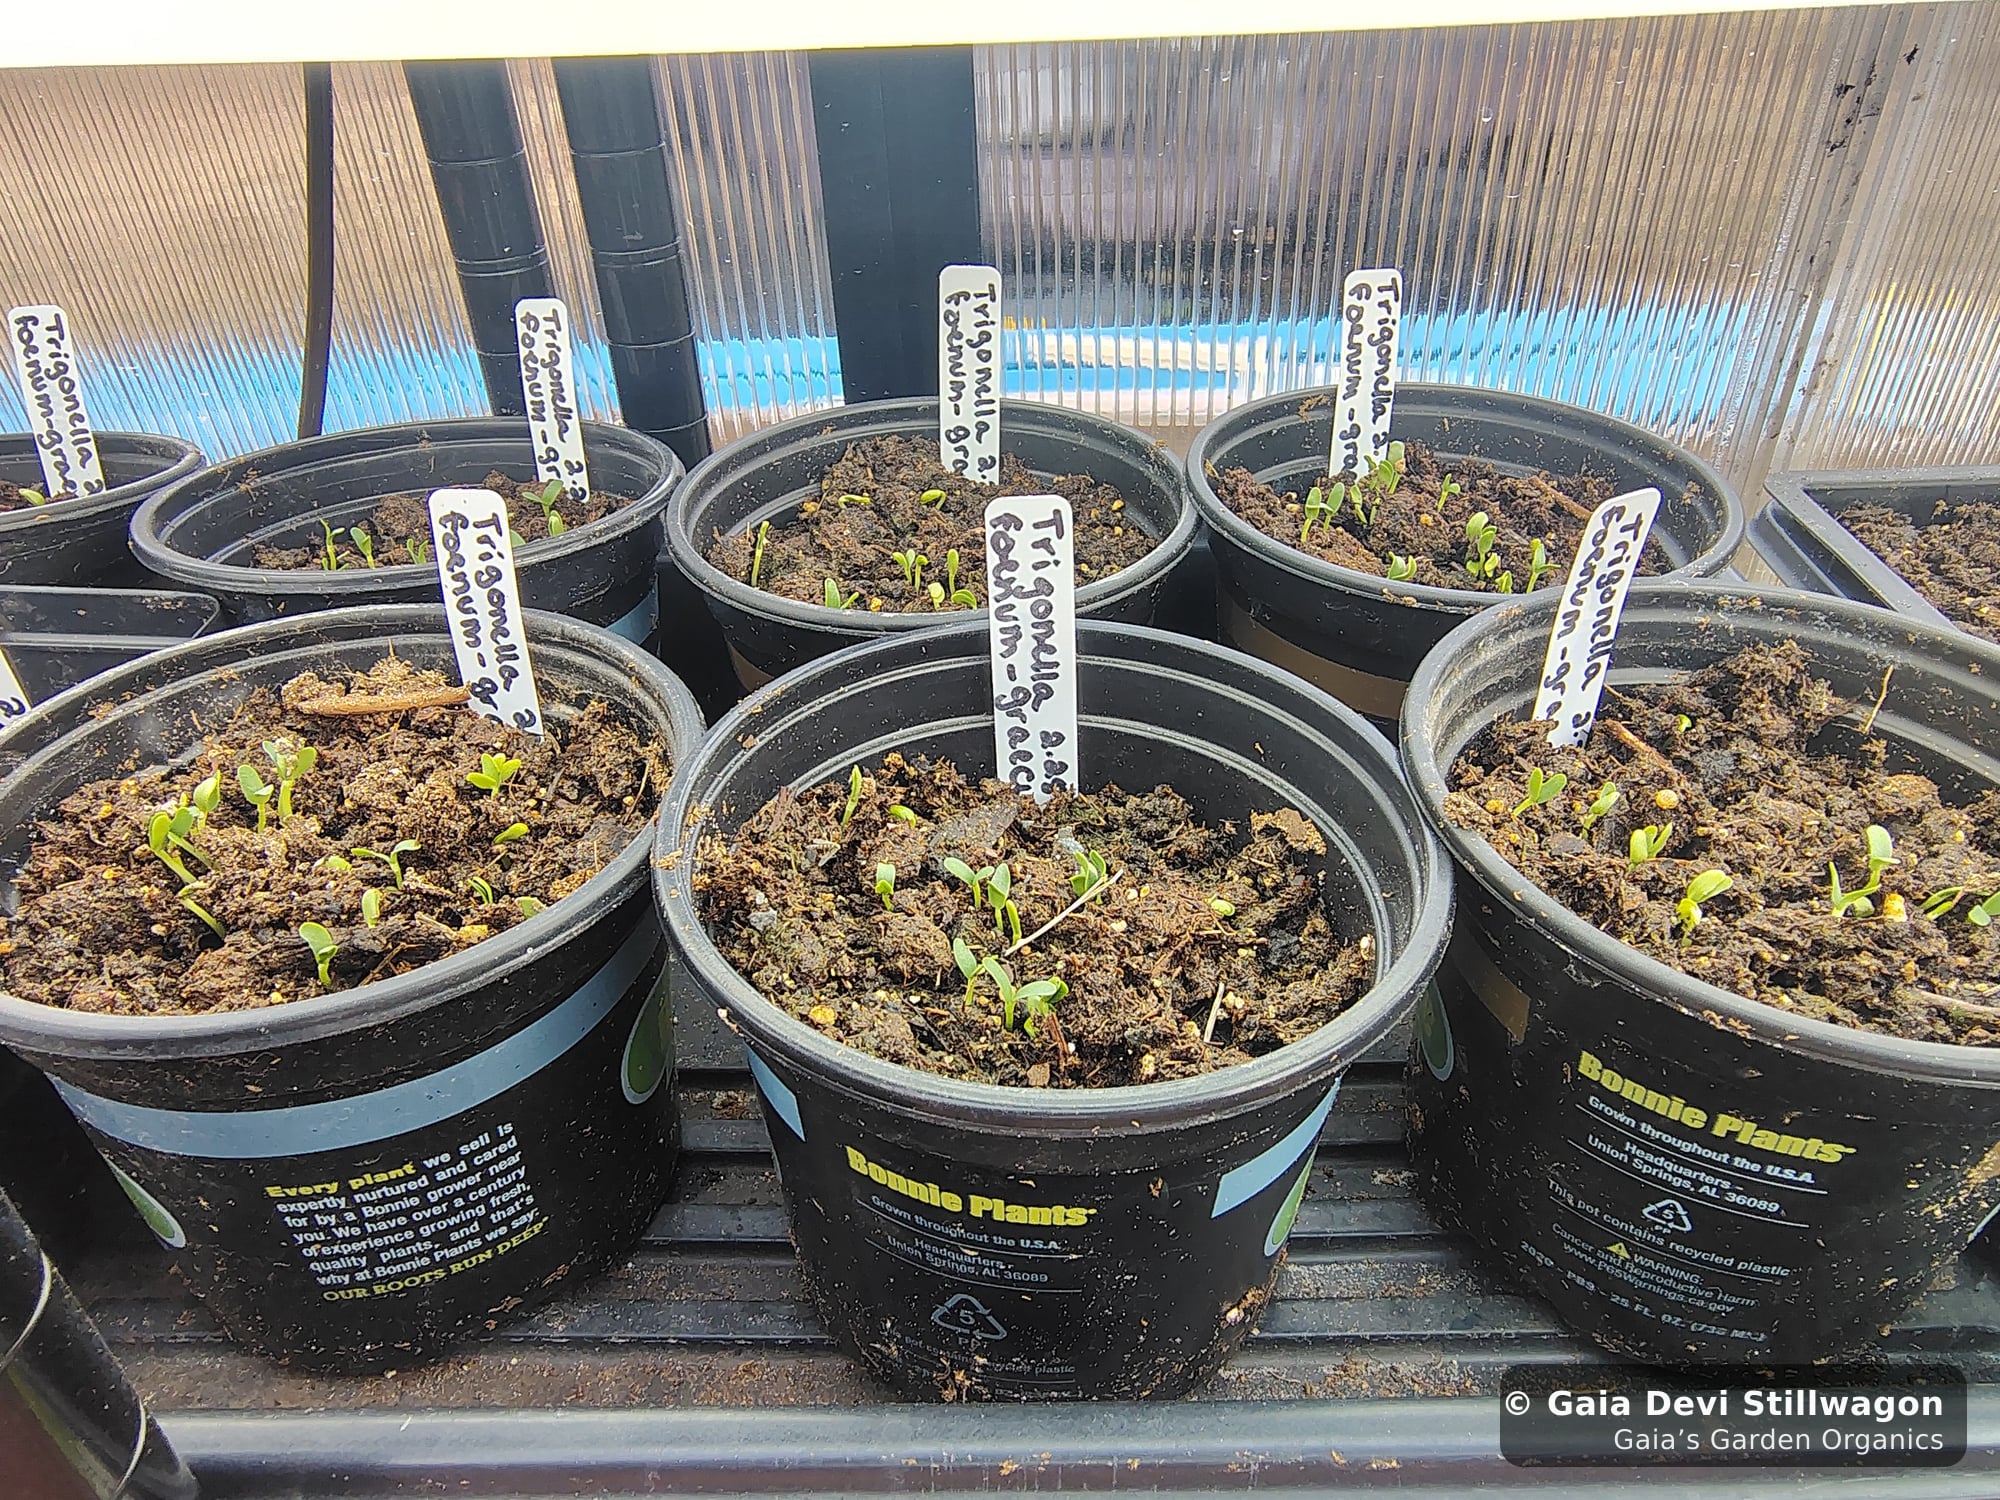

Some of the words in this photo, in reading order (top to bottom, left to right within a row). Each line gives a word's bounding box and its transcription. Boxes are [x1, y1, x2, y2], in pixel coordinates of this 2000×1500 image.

[45, 313, 93, 469] Trigonella
[540, 308, 573, 444] Trigonella
[965, 283, 997, 444] Trigonella
[1367, 277, 1400, 426] Trigonella
[473, 512, 520, 692] Trigonella
[1013, 508, 1064, 712] Trigonella
[1581, 512, 1643, 692] Trigonella
[1578, 1050, 1709, 1129] Bonnie
[1710, 1112, 1847, 1164] Plants
[1587, 1095, 1637, 1129] Grown
[1639, 1121, 1732, 1166] throughout
[1733, 1155, 1762, 1173] the
[264, 1180, 339, 1198] Every
[348, 1162, 416, 1190] plant
[423, 1152, 452, 1170] we
[459, 1132, 491, 1156] sell
[497, 1122, 514, 1138] is
[276, 1196, 346, 1214] expertly
[353, 1174, 430, 1204] nurtured
[435, 1160, 468, 1182] and
[473, 1135, 518, 1166] cared
[284, 1215, 309, 1228] for
[315, 1213, 336, 1227] by
[344, 1211, 358, 1222] a
[362, 1196, 421, 1219] Bonnie
[426, 1171, 483, 1203] grower
[487, 1150, 522, 1177] near
[846, 1145, 963, 1213] Bonnie
[968, 1194, 1088, 1226] Plants
[1587, 1134, 1629, 1164] Union
[1631, 1157, 1696, 1192] Springs,
[1698, 1180, 1721, 1200] AL
[1724, 1190, 1781, 1214] 36089
[1624, 1140, 1732, 1190] Headquarters
[293, 1231, 332, 1244] you.
[332, 1225, 361, 1240] We
[365, 1214, 408, 1234] have
[411, 1202, 449, 1222] over
[453, 1197, 466, 1208] a
[468, 1165, 526, 1202] century
[302, 1244, 319, 1257] of
[321, 1231, 415, 1256] experience
[419, 1204, 487, 1238] growing
[489, 1182, 532, 1208] fresh,
[309, 1254, 368, 1273] quality
[379, 1239, 441, 1264] plants,
[449, 1221, 481, 1242] and
[489, 1193, 535, 1224] that's
[871, 1195, 912, 1221] Grown
[914, 1213, 990, 1245] throughout
[992, 1236, 1016, 1248] the
[1548, 1177, 1575, 1202] This
[1577, 1200, 1601, 1217] pot
[1603, 1213, 1666, 1246] contains
[1668, 1240, 1735, 1267] recycled
[1737, 1259, 1792, 1277] plastic
[1661, 1207, 1675, 1220] 5
[316, 1272, 350, 1286] why
[354, 1269, 372, 1282] at
[375, 1255, 431, 1278] Bonnie
[434, 1236, 483, 1263] Plants
[485, 1224, 508, 1242] we
[323, 1287, 369, 1301] OUR
[371, 1268, 448, 1298] ROOTS
[450, 1249, 494, 1275] RUN
[887, 1234, 923, 1260] Union
[925, 1252, 979, 1277] Springs,
[982, 1266, 1001, 1280] AL
[1003, 1270, 1049, 1284] 36089
[914, 1237, 1004, 1269] Headquarters
[1552, 1222, 1595, 1253] Cancer
[1596, 1248, 1621, 1266] and
[1624, 1261, 1715, 1299] Reproductive
[1717, 1292, 1756, 1308] Harm
[1633, 1253, 1705, 1286] WARNING:
[958, 1309, 976, 1325] 5
[1034, 1363, 1076, 1377] plastic
